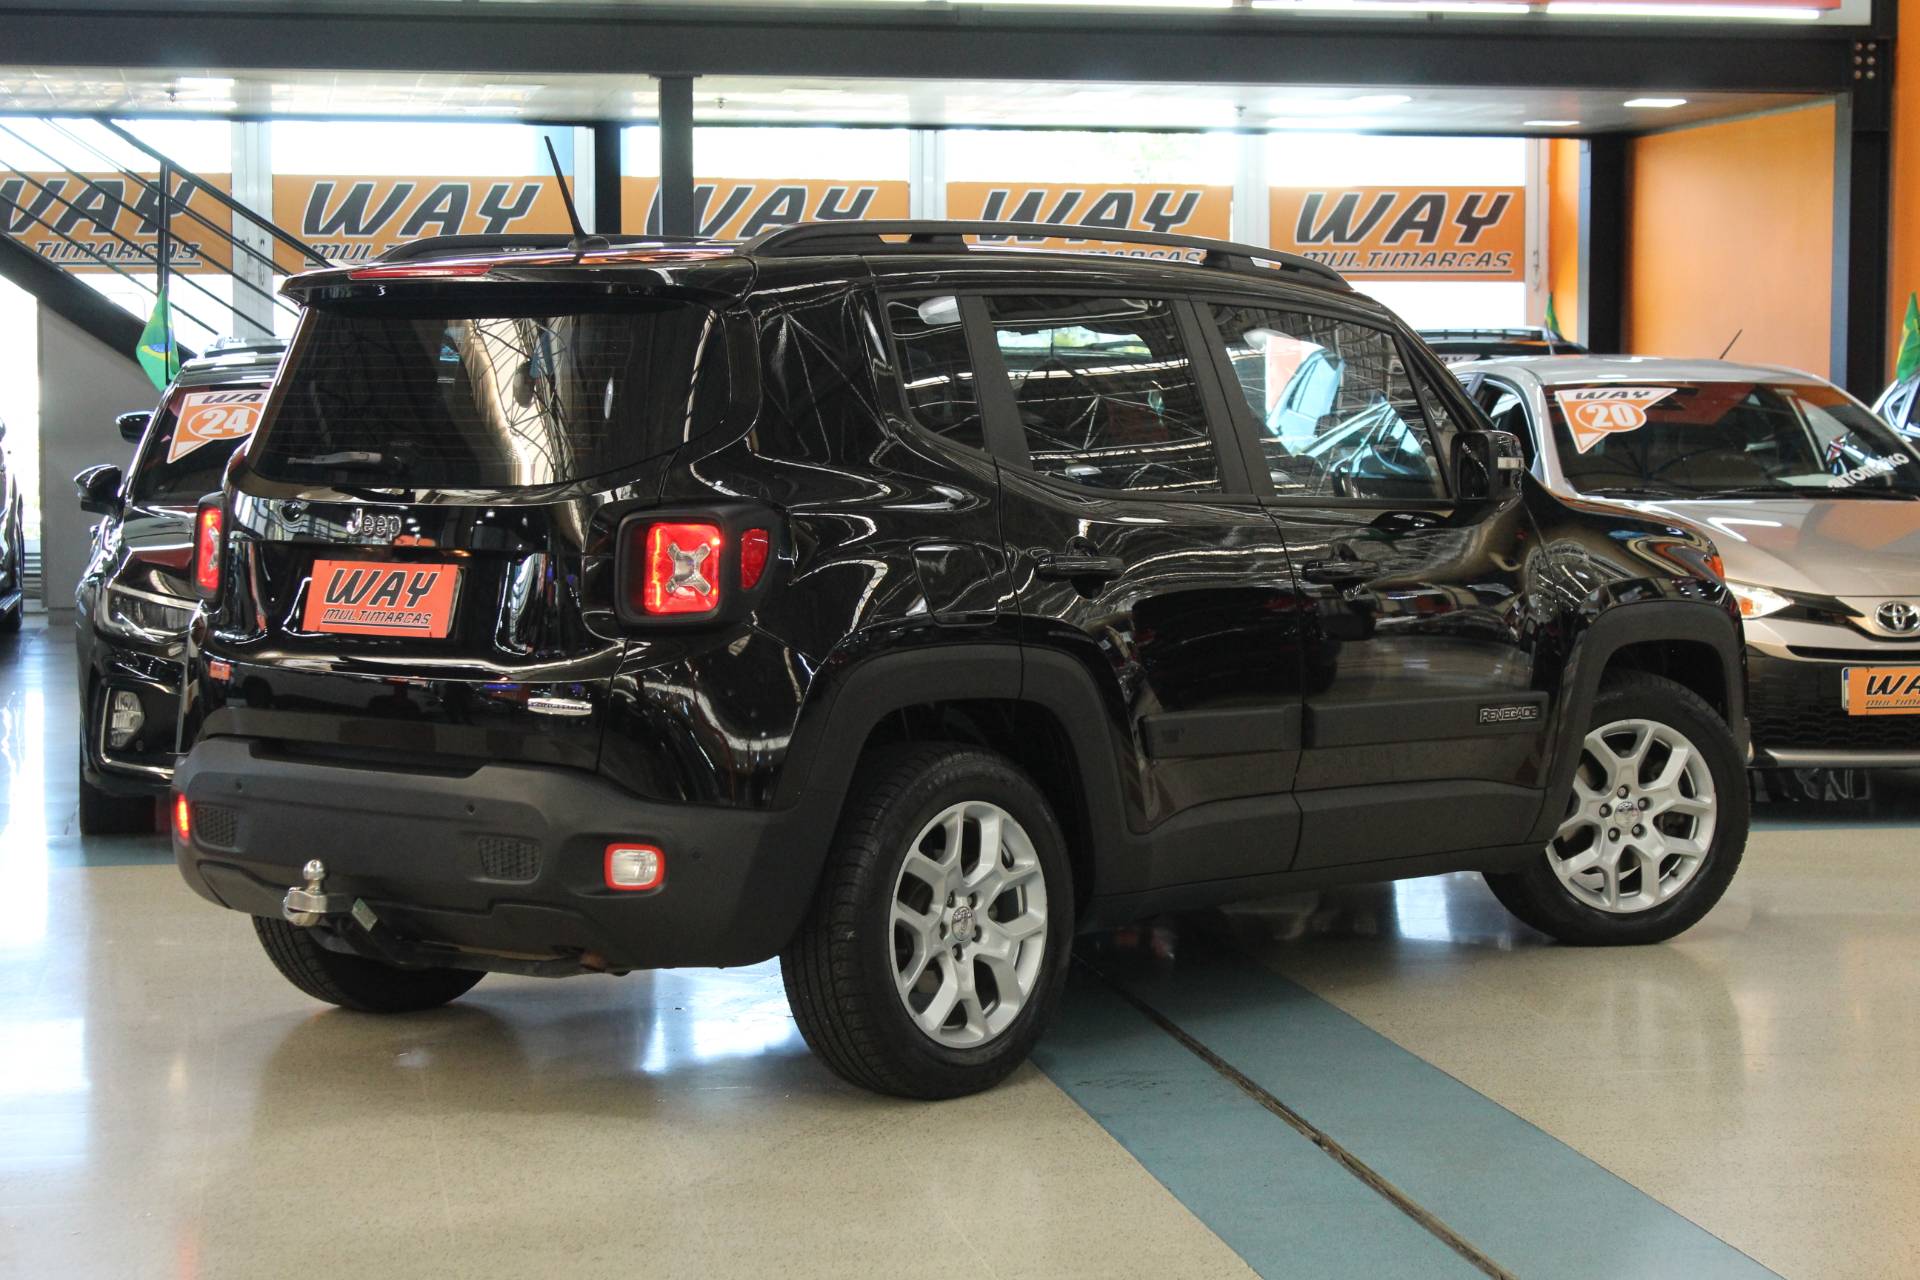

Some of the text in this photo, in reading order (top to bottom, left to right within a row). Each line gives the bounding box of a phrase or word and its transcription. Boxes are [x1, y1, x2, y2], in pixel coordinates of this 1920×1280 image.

[303, 181, 544, 238] WAY
[977, 189, 1203, 245] WAY
[1295, 191, 1514, 246] WAY
[1303, 251, 1514, 269] MULTIMARCAS
[202, 393, 262, 404] WA
[1575, 391, 1650, 400] WAY
[198, 409, 250, 434] 24
[1586, 404, 1637, 427] 20
[346, 508, 402, 541] Jeep
[323, 568, 441, 608] WAY
[323, 608, 432, 625] MULTIMARCAS
[1866, 675, 1920, 696] WA
[1480, 706, 1537, 722] RENEGADE
